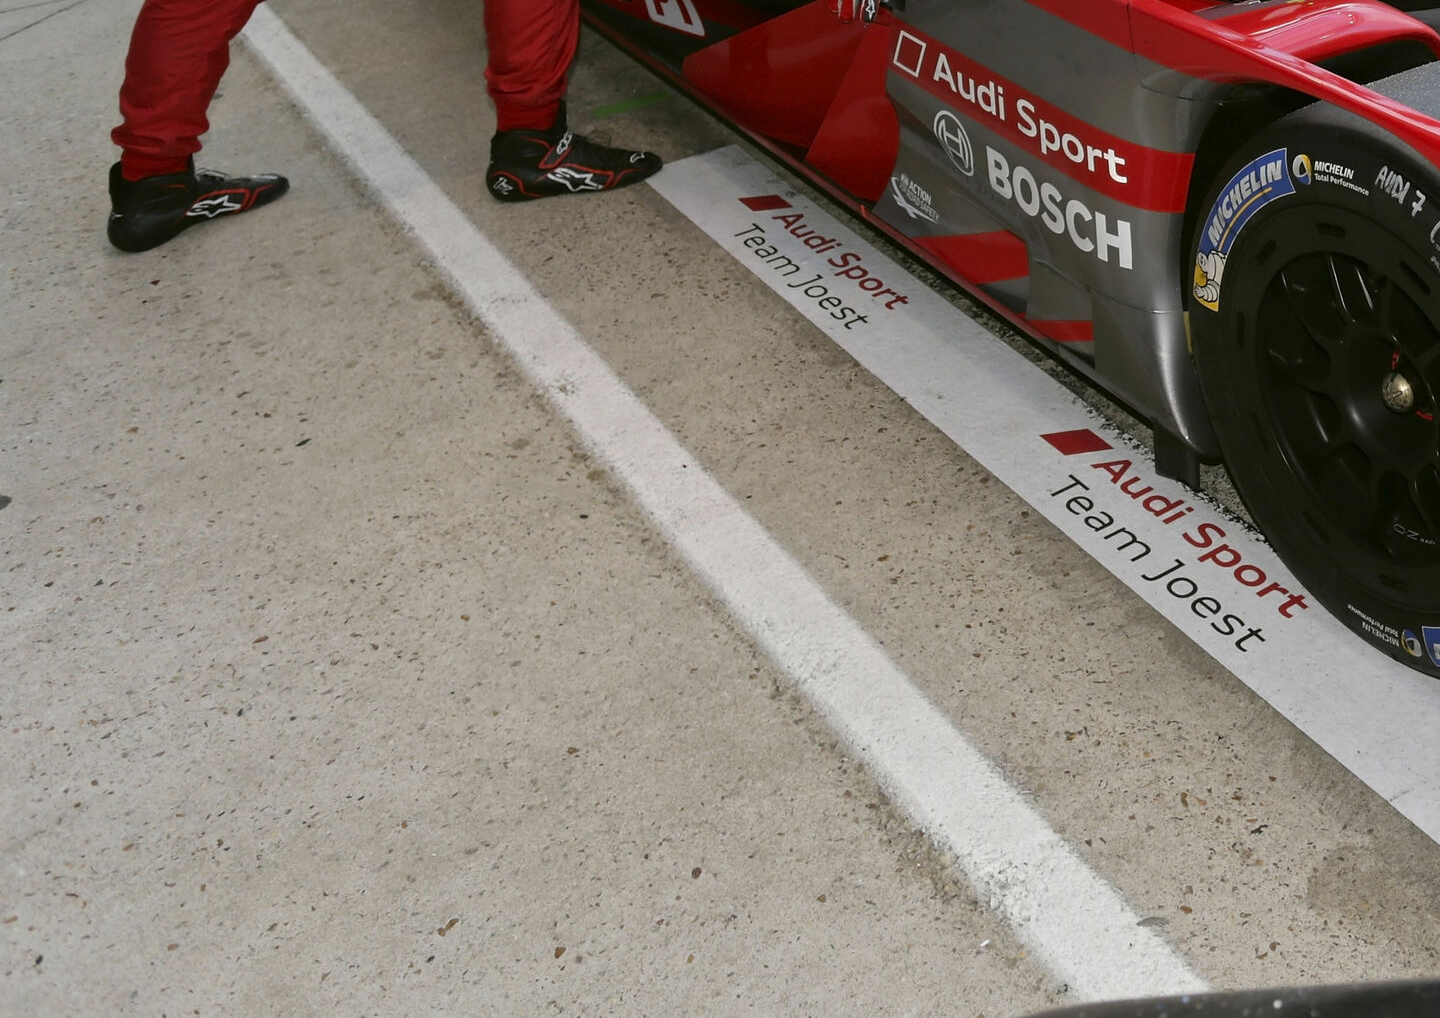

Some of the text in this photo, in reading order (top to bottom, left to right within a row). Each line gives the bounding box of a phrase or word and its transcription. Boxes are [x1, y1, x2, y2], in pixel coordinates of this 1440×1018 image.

[933, 52, 1128, 184] Audi Sport
[909, 180, 932, 206] ACTION
[986, 146, 1132, 270] BOSCH
[1207, 160, 1284, 248] MICHELIN
[1314, 161, 1354, 180] MICHELIN
[1314, 173, 1370, 197] Total Performance
[1411, 190, 1427, 218] 7
[734, 223, 868, 330] Team Joest
[772, 213, 909, 310] Audi Sport
[1050, 474, 1266, 653] Team Joest
[1090, 459, 1309, 619] Audi Sport
